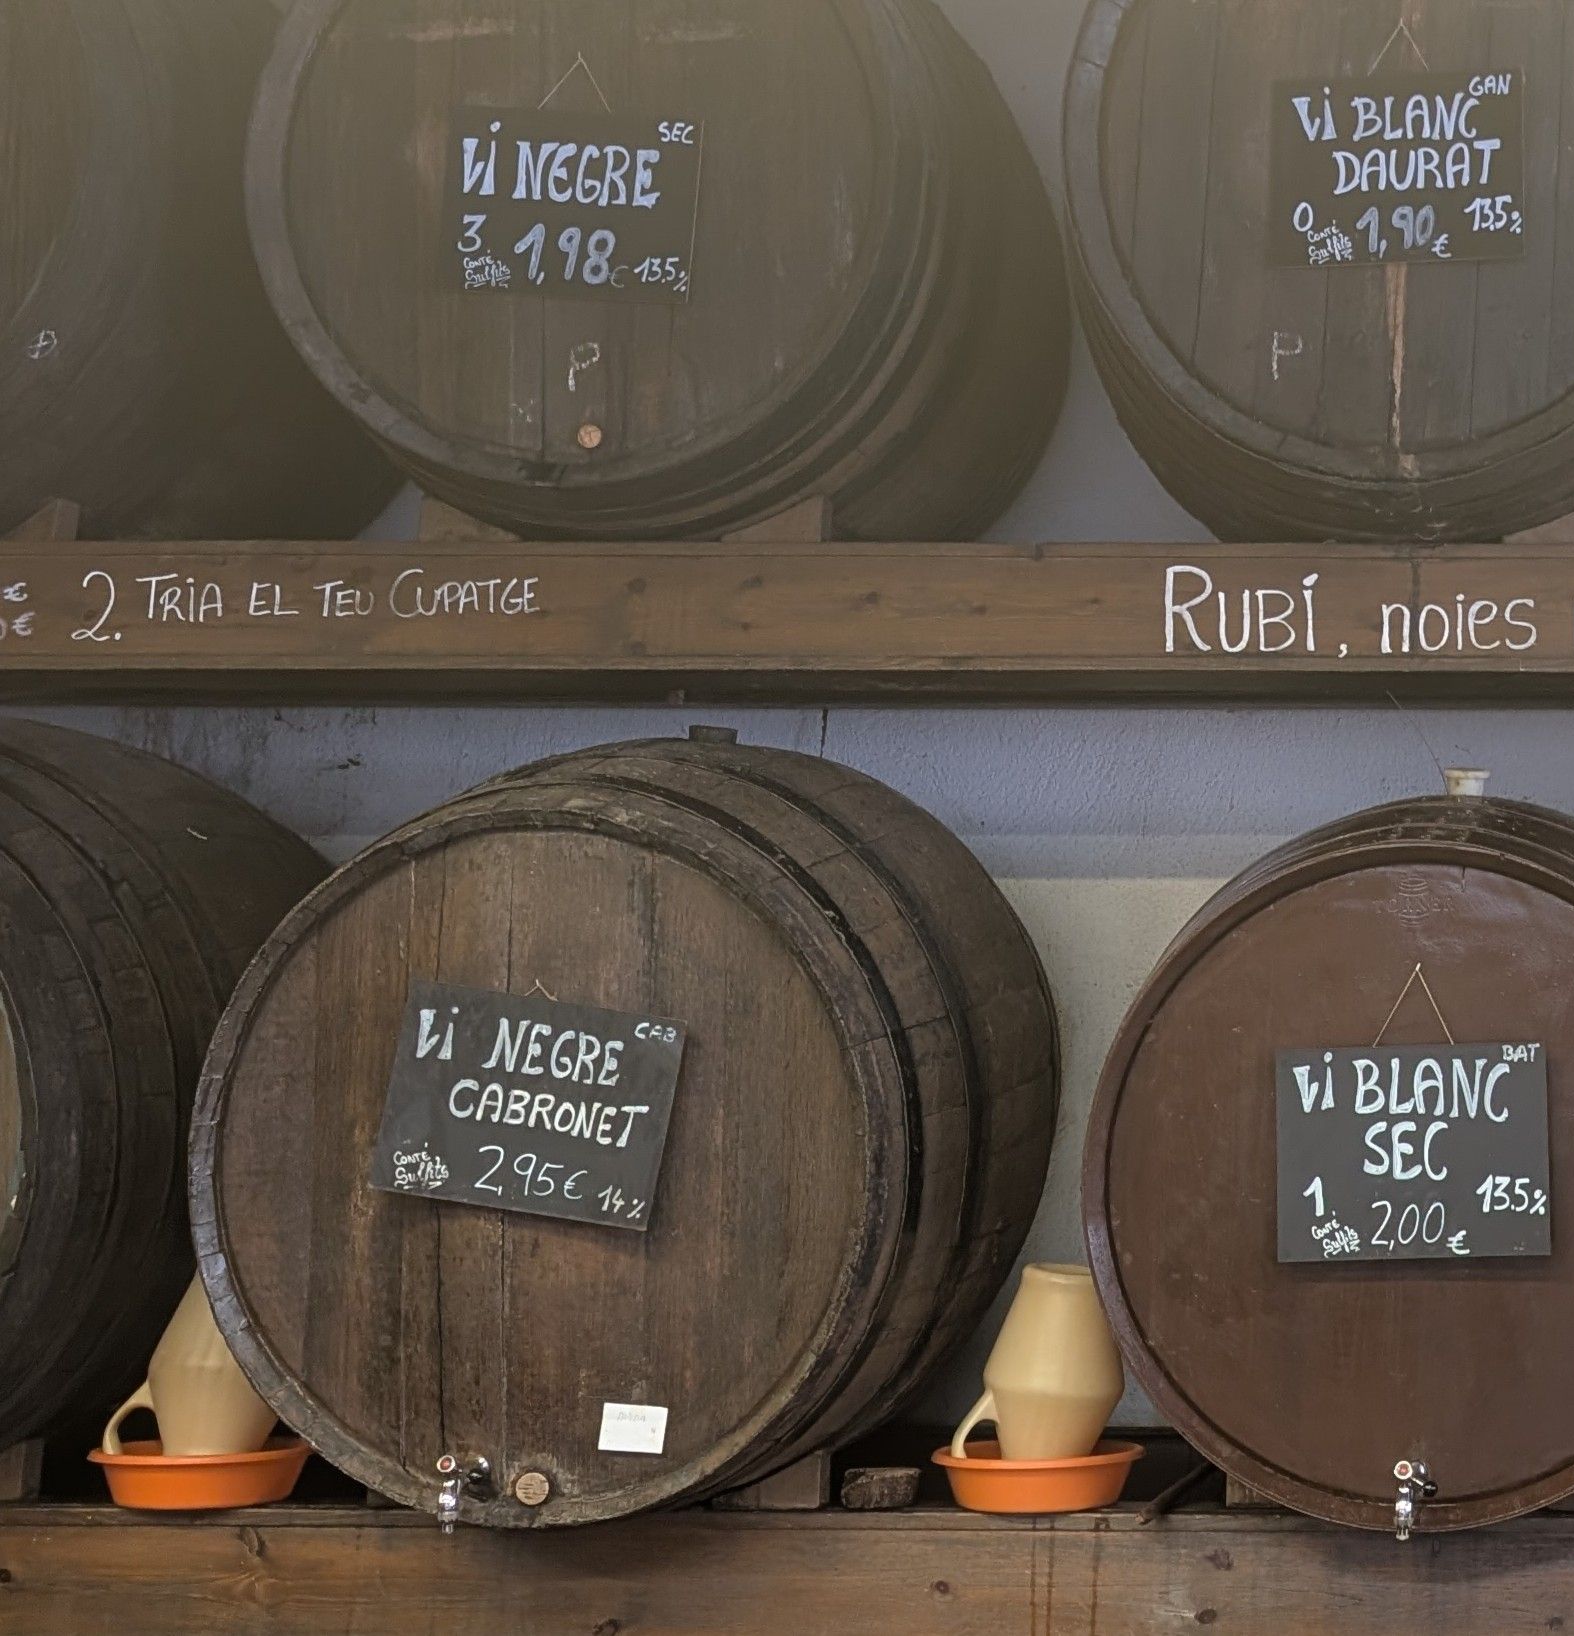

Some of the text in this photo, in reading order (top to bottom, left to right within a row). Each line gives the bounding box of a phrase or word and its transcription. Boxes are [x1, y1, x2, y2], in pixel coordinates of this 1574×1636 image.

[1468, 73, 1511, 97] GAN
[658, 121, 694, 144] SEC
[1351, 92, 1480, 141] BLANC
[512, 141, 661, 208] NEGRE
[1332, 138, 1501, 195] DAURAT
[457, 214, 487, 252] 3
[71, 570, 122, 641] 2.
[249, 581, 300, 616] EL
[313, 579, 374, 617] TEU
[390, 569, 540, 619] CUPATGE
[1380, 593, 1537, 653] noies
[481, 1017, 625, 1087] NEGRE
[1502, 1043, 1541, 1063] BAT
[449, 1078, 650, 1148] CABRONET
[1352, 1057, 1511, 1122] BLANC
[1363, 1121, 1449, 1181] SEC
[1303, 1176, 1325, 1217] 1
